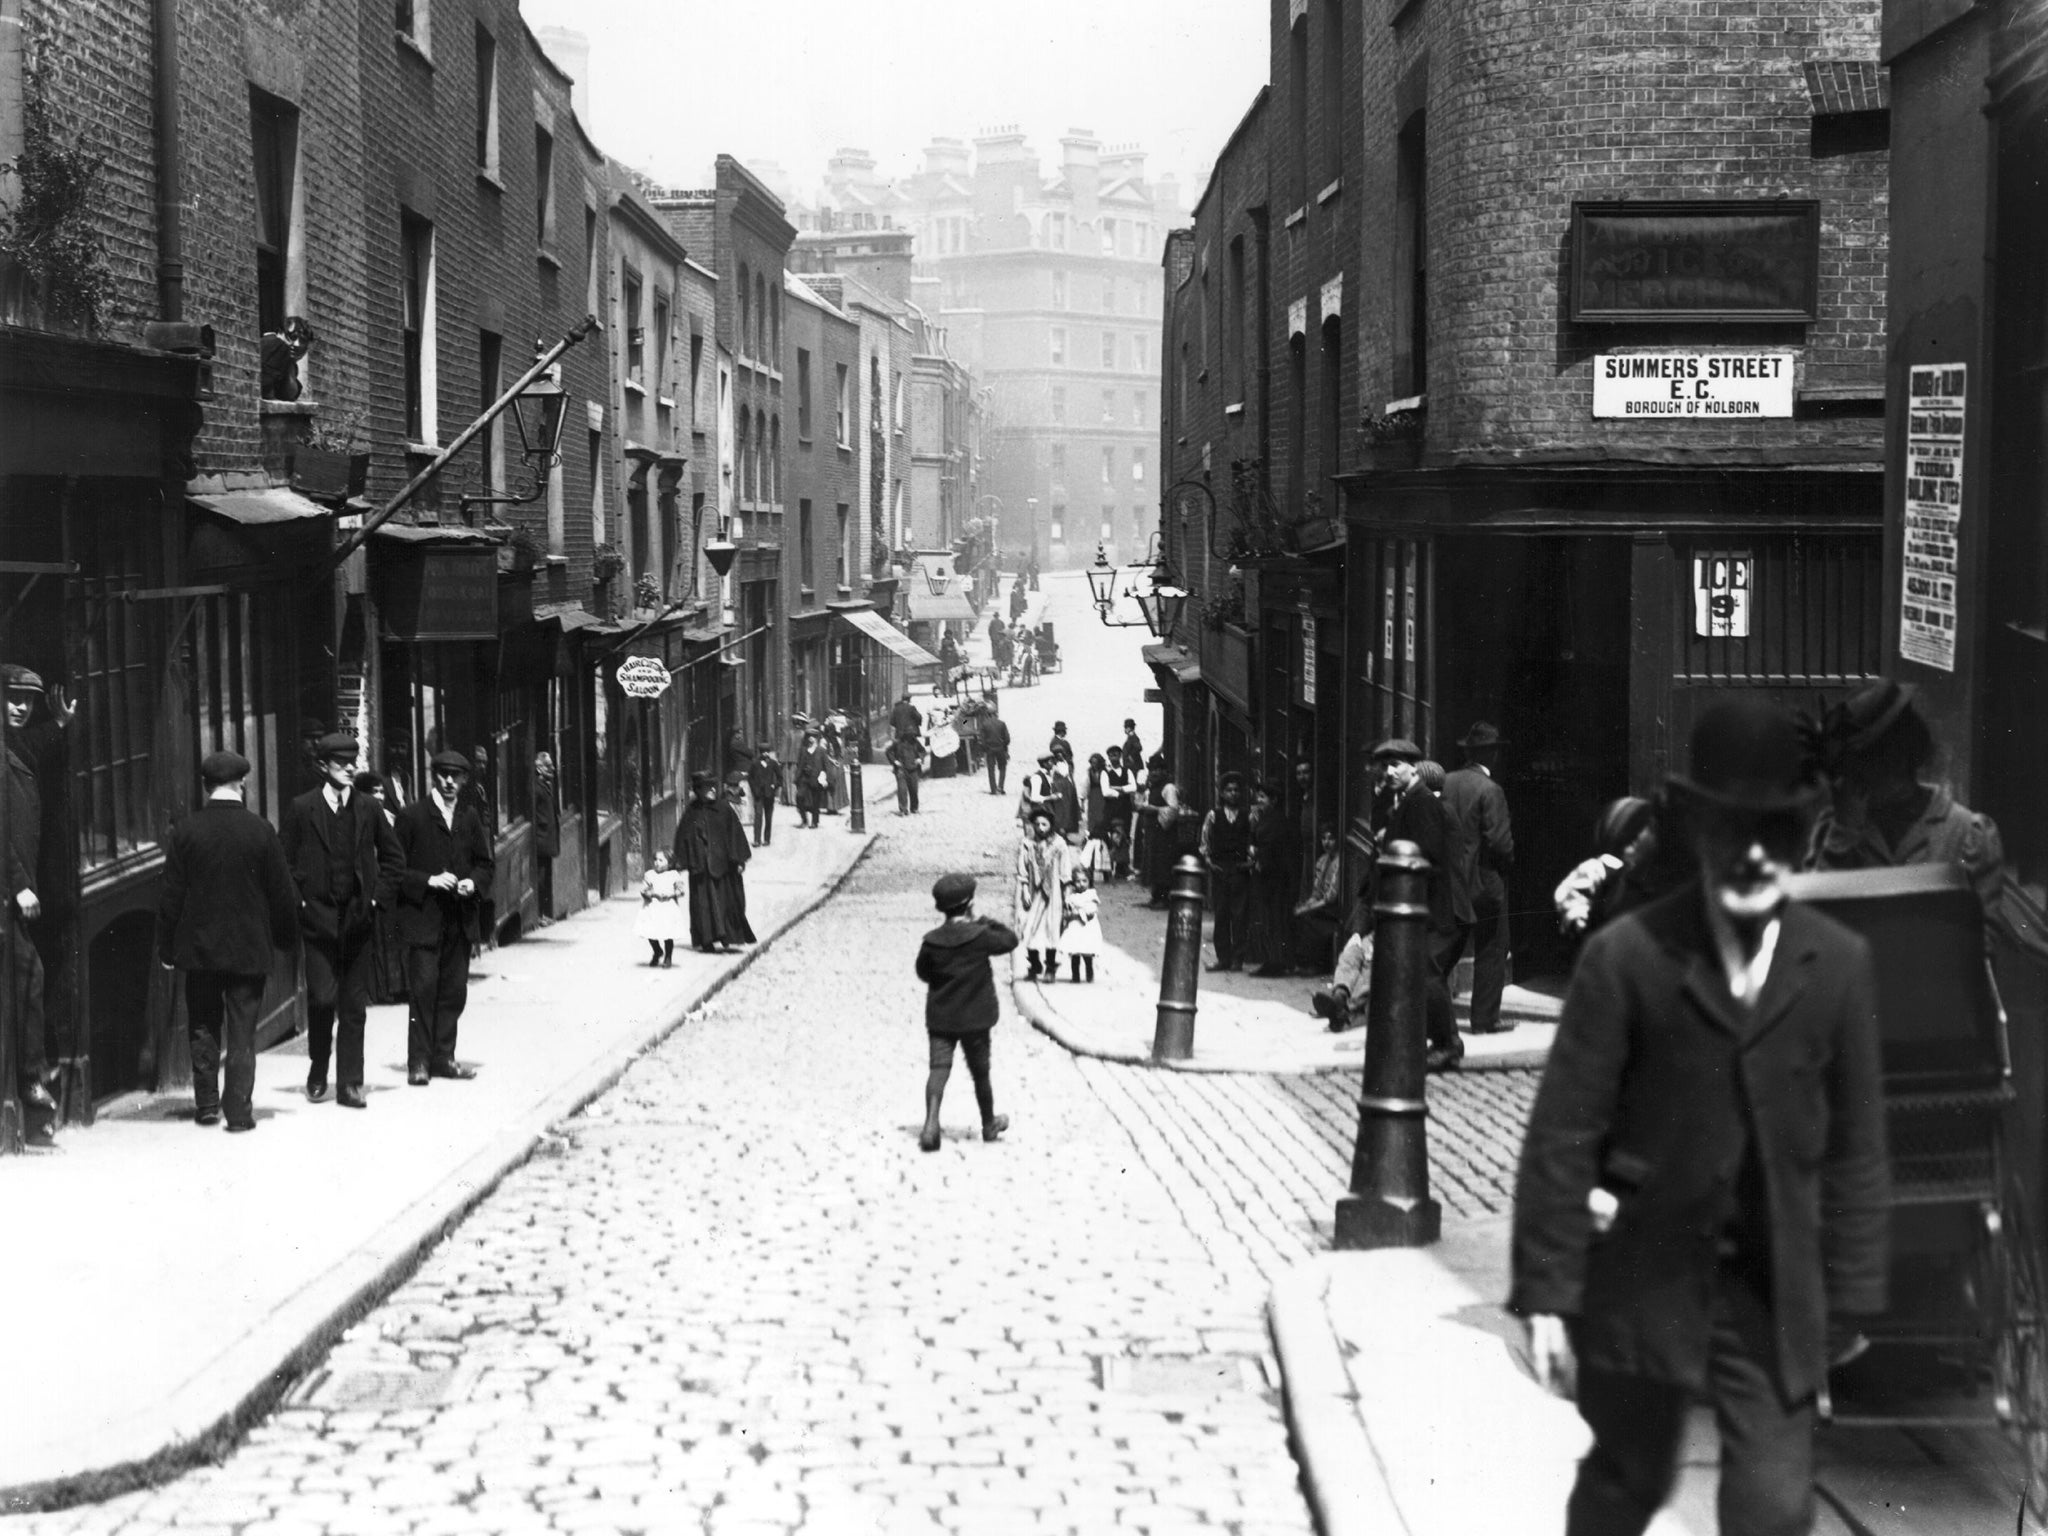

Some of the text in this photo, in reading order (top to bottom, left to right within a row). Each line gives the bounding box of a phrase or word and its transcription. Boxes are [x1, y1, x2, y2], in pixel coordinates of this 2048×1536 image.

[1605, 358, 1782, 378] SUMMERS STREET
[1625, 401, 1760, 413] BOROUGH OF HOLBORN
[1699, 557, 1748, 590] ICE
[620, 673, 669, 684] SHAMPOOING
[628, 683, 659, 694] SALOON
